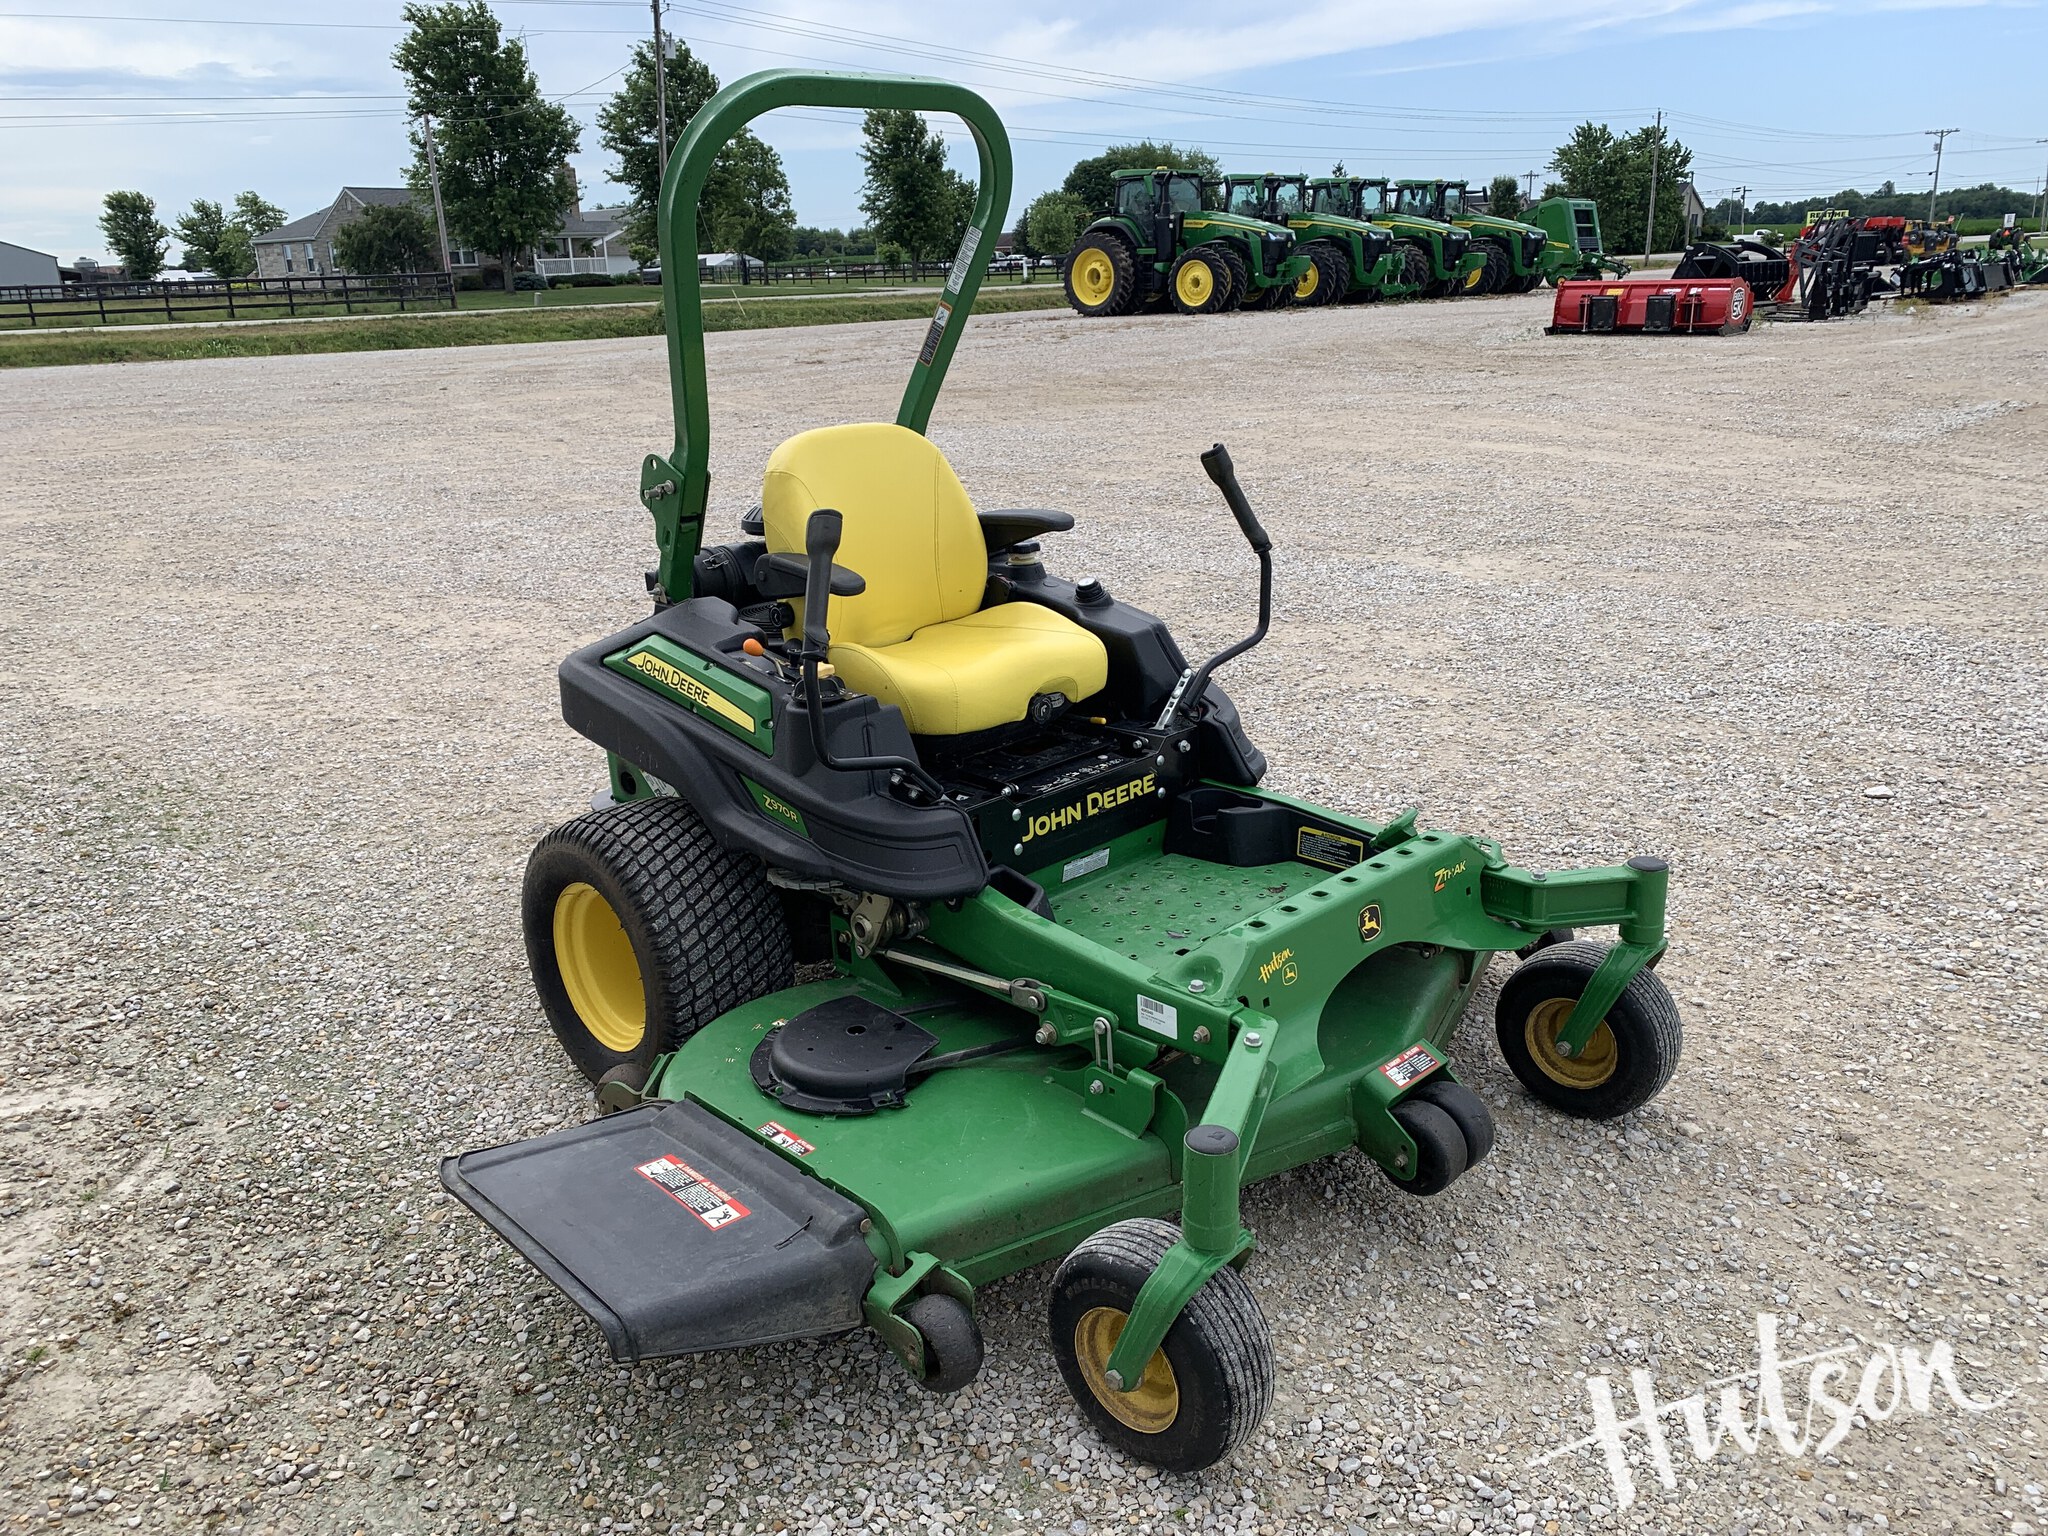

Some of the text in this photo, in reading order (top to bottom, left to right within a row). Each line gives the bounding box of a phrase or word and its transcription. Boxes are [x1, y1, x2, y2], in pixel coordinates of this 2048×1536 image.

[637, 654, 711, 705] JOHN DEERE
[762, 793, 799, 823] Z970R
[1022, 802, 1082, 842] JOHN
[1087, 773, 1156, 816] DEERE
[1258, 948, 1295, 984] Hutson
